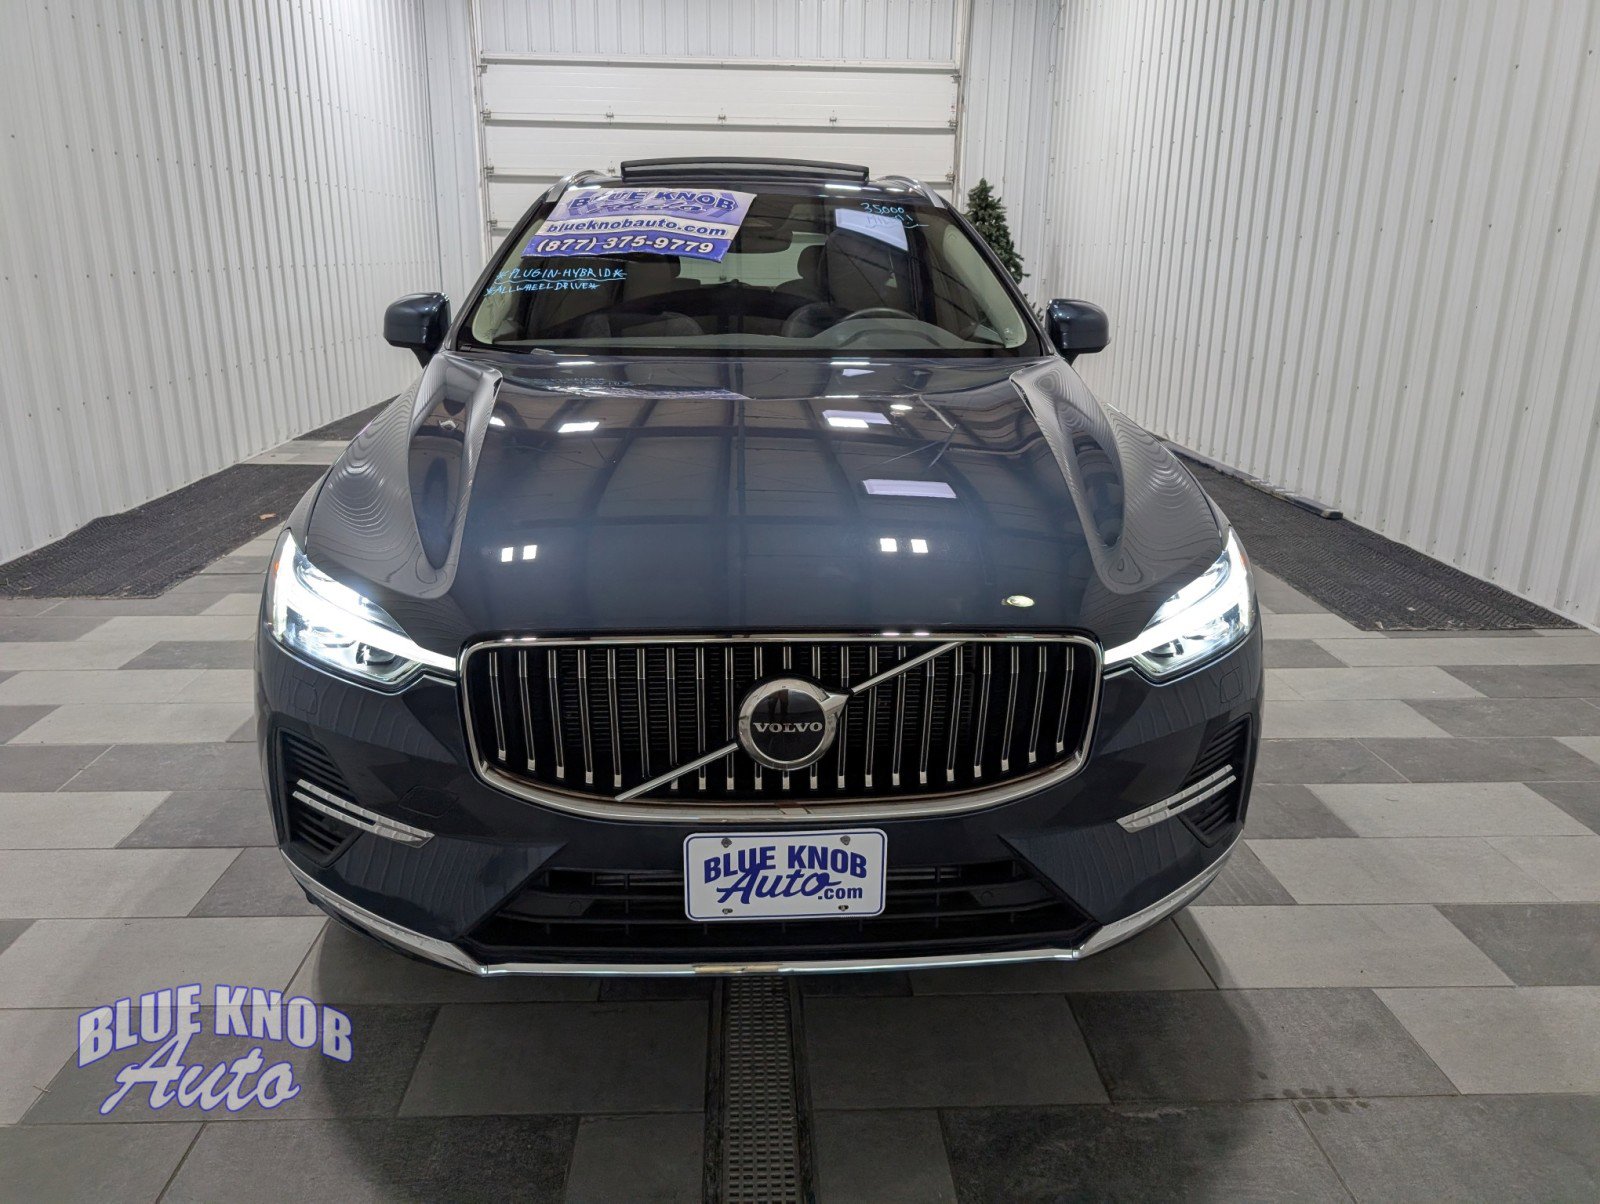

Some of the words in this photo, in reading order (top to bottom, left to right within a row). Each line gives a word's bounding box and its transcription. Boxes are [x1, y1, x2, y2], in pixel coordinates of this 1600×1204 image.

[568, 191, 649, 208] BUE
[654, 191, 735, 211] KNOB
[546, 218, 727, 238] blueknobauto.com
[536, 238, 597, 253] (877)
[602, 235, 715, 254] 375-9779
[753, 722, 823, 733] VOLVO
[704, 846, 776, 884] BLUE
[787, 845, 867, 879] KNOB
